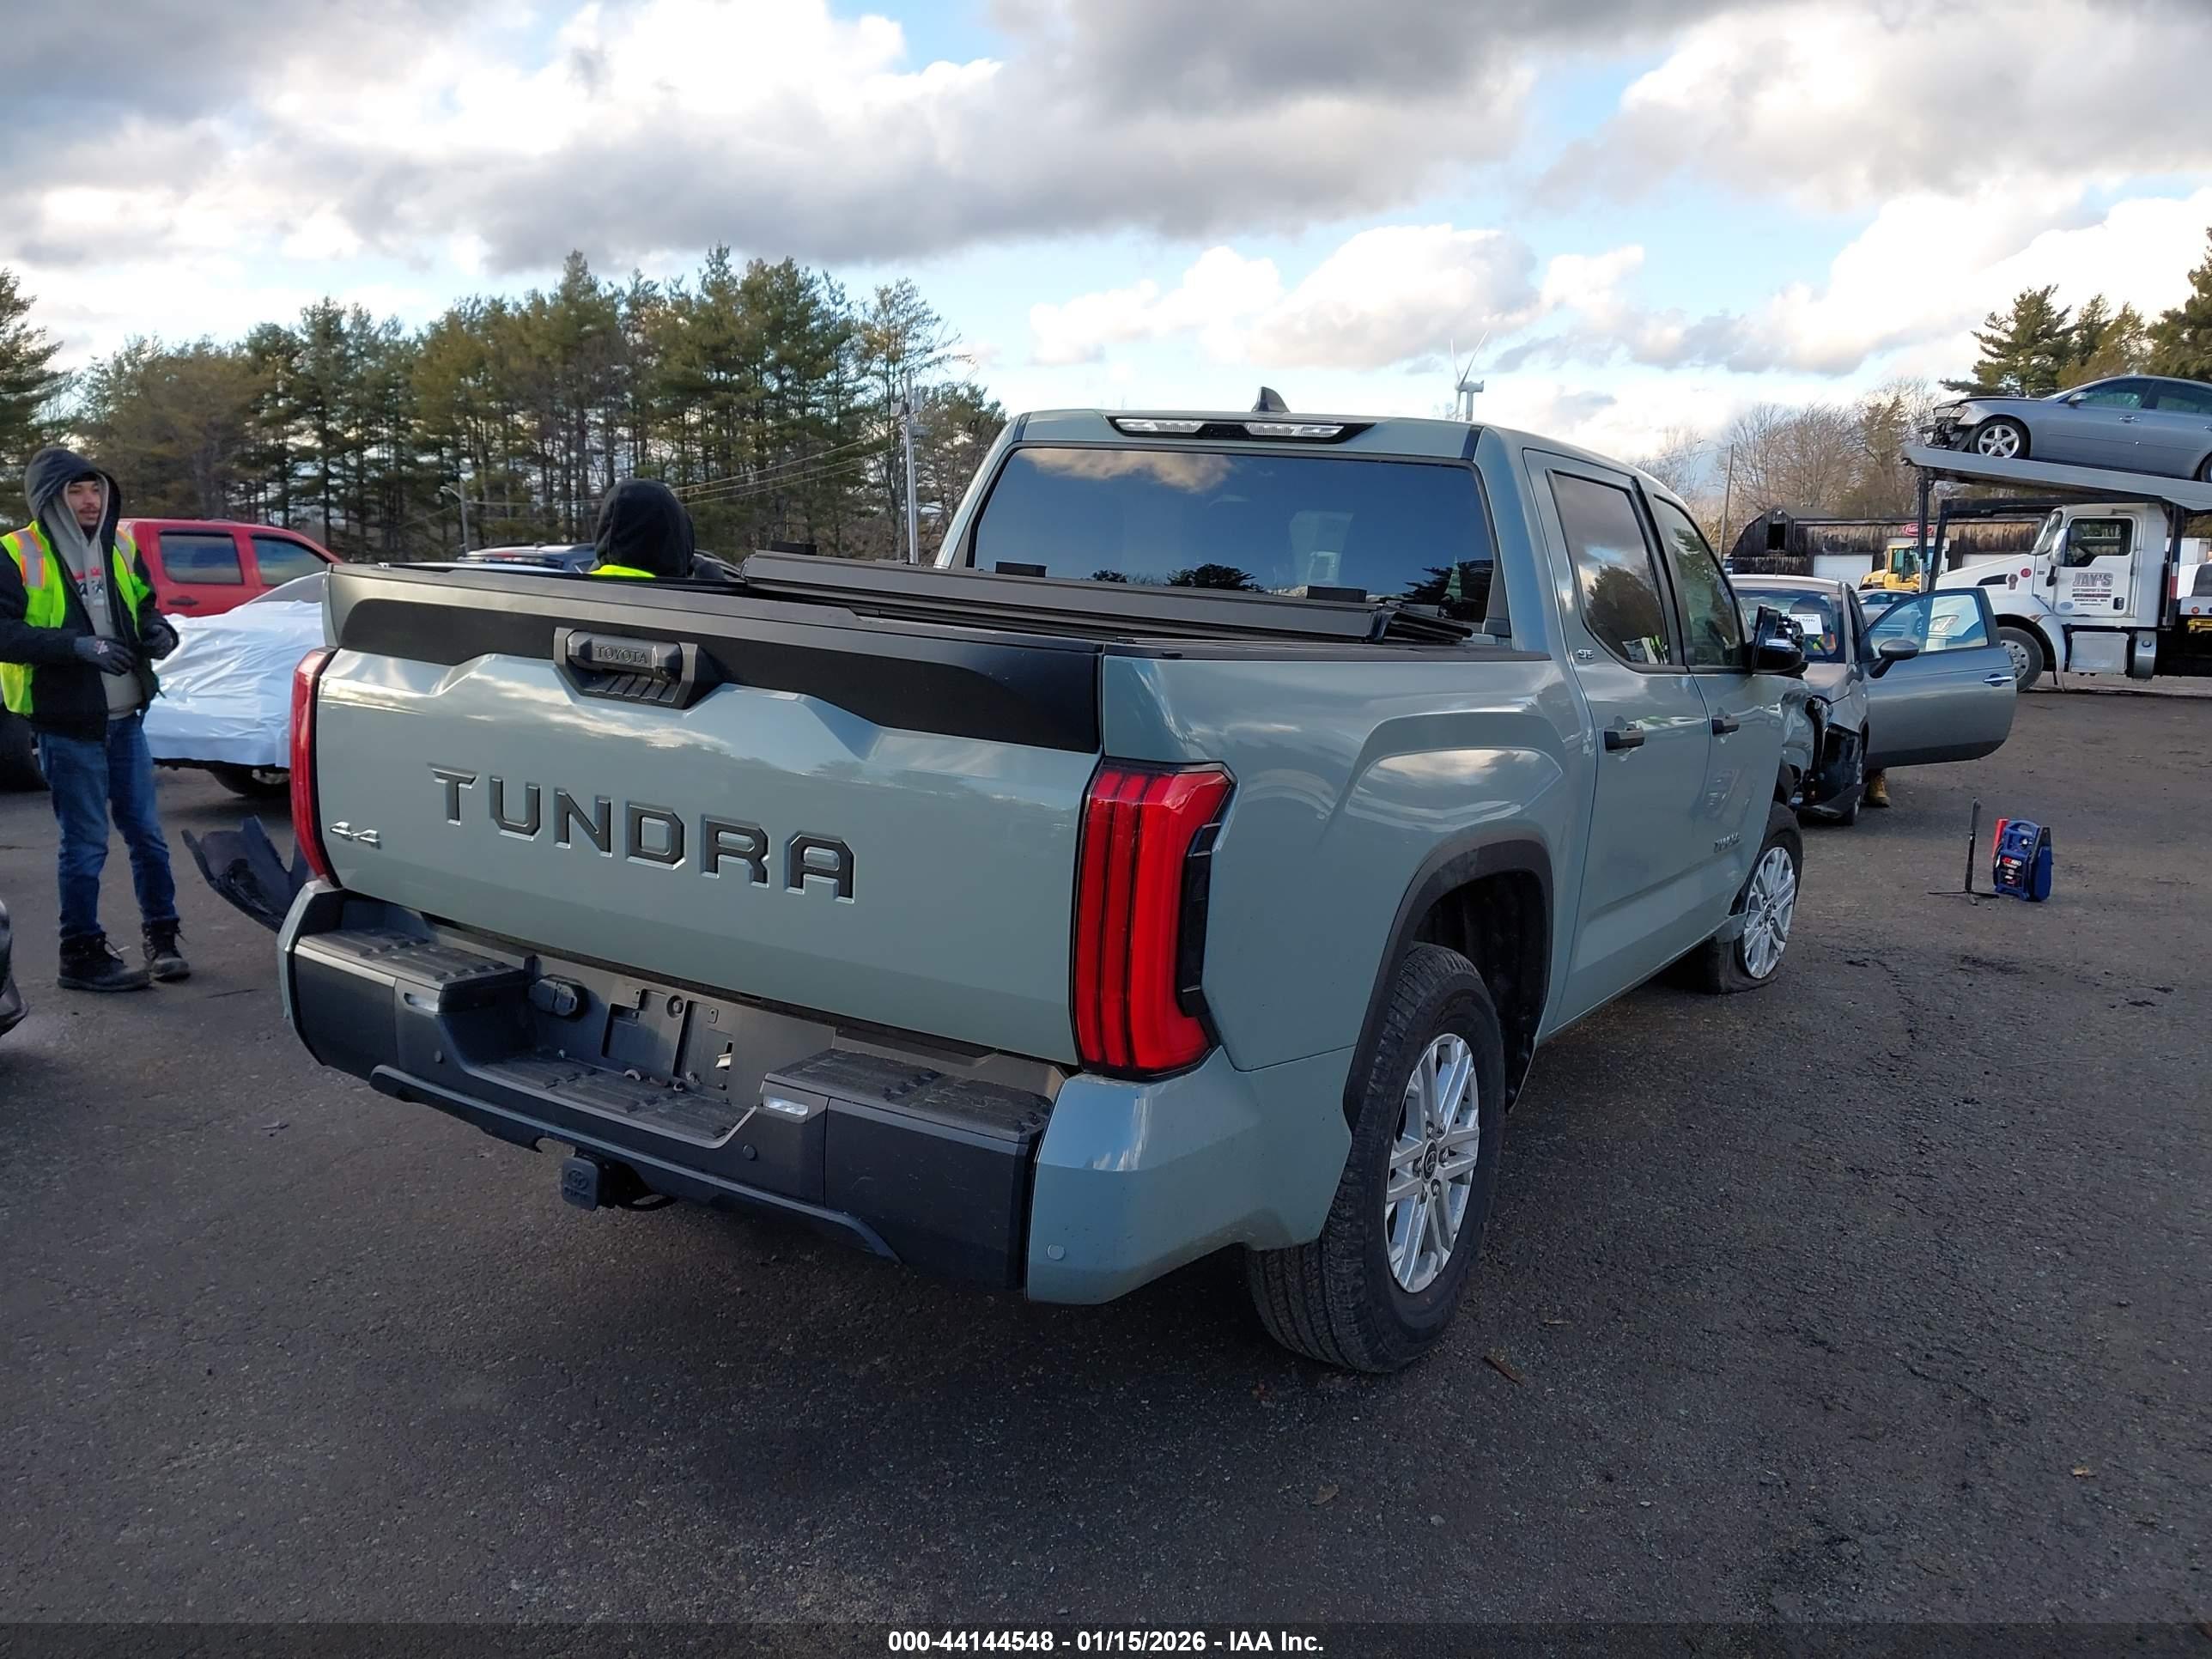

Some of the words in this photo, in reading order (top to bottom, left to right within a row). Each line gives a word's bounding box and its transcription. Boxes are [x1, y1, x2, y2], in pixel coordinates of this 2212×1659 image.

[2072, 572, 2114, 587] JAY'S
[596, 646, 648, 664] TOYOTA
[428, 763, 856, 904] TUNDRA
